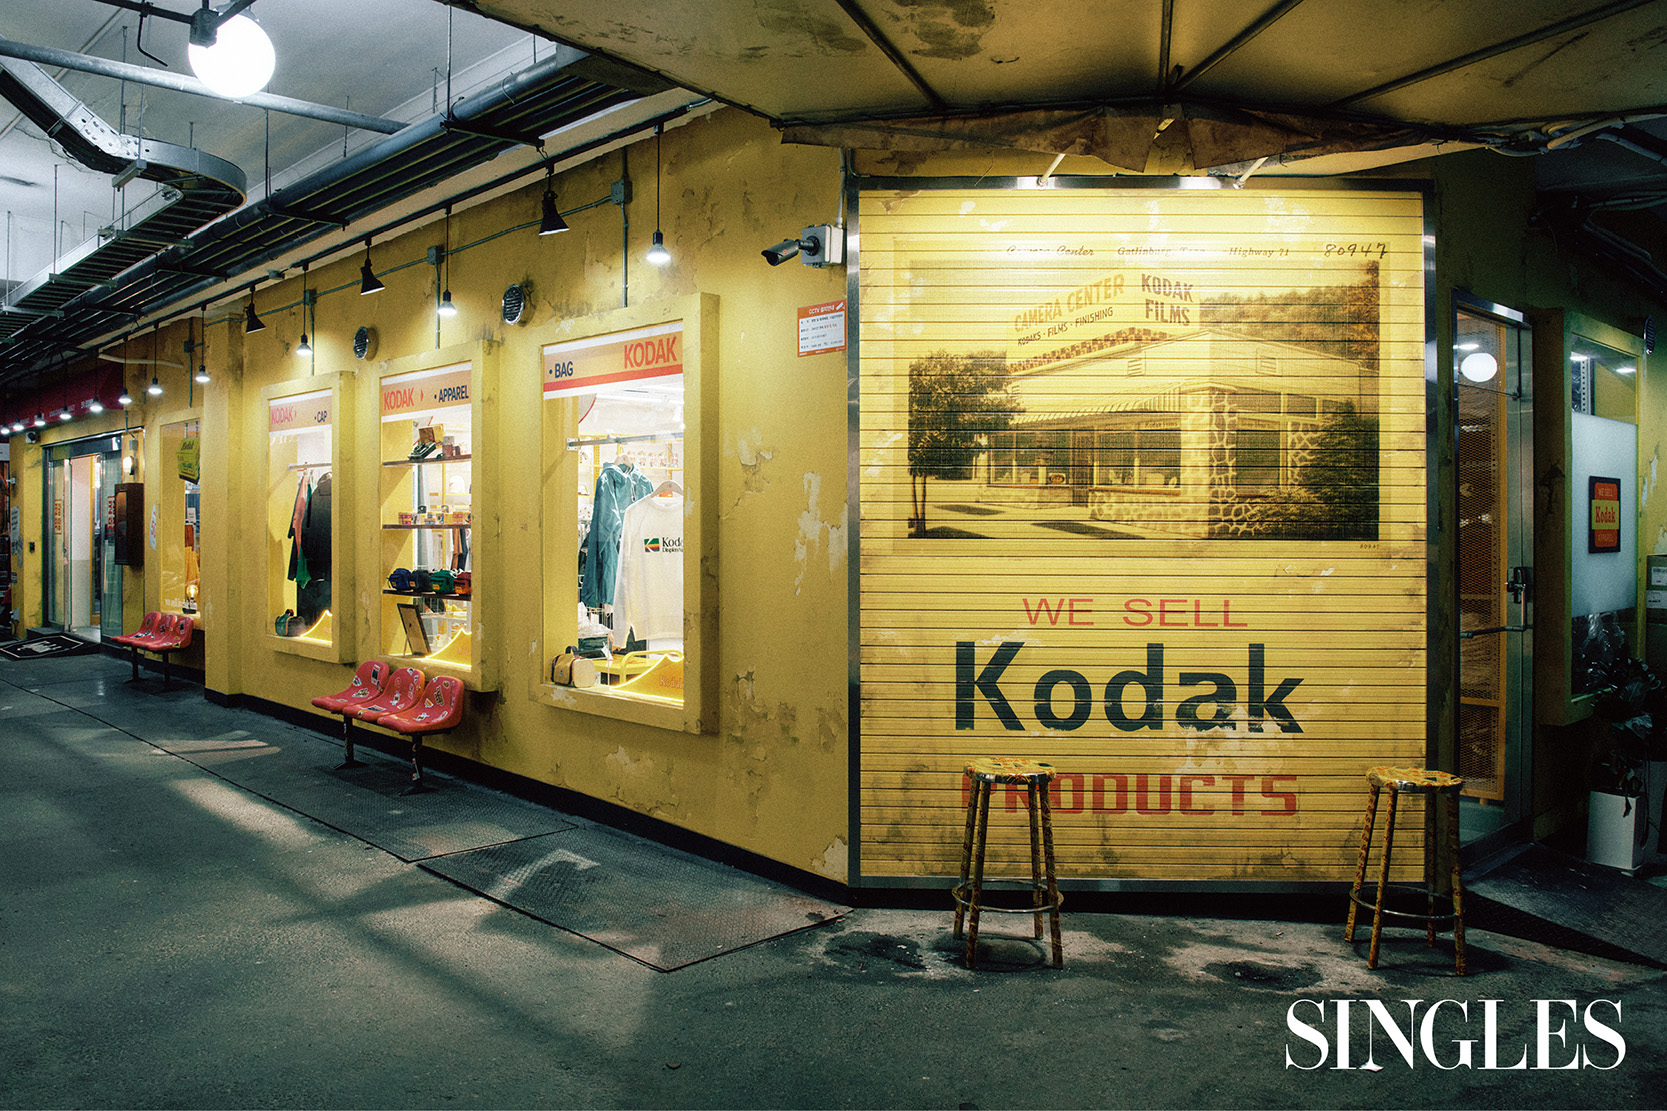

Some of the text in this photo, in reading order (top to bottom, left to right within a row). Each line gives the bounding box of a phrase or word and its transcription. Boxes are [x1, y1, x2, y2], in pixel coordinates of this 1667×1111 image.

[1056, 244, 1095, 256] Center
[1229, 247, 1275, 257] Highway
[1323, 242, 1389, 259] 80947
[1141, 273, 1194, 303] KODAK
[1014, 273, 1126, 332] CAMERA CENTER
[1145, 299, 1191, 326] FILMS
[1047, 322, 1069, 337] FILMS
[1075, 306, 1114, 328] FINISHING
[554, 336, 678, 378] BAG KODAK
[384, 385, 469, 411] KODAK APPAREL
[271, 406, 328, 424] KODAK CAP
[1595, 506, 1616, 524] Kodak
[1022, 598, 1248, 628] WE SELL
[955, 641, 1305, 734] Kodak
